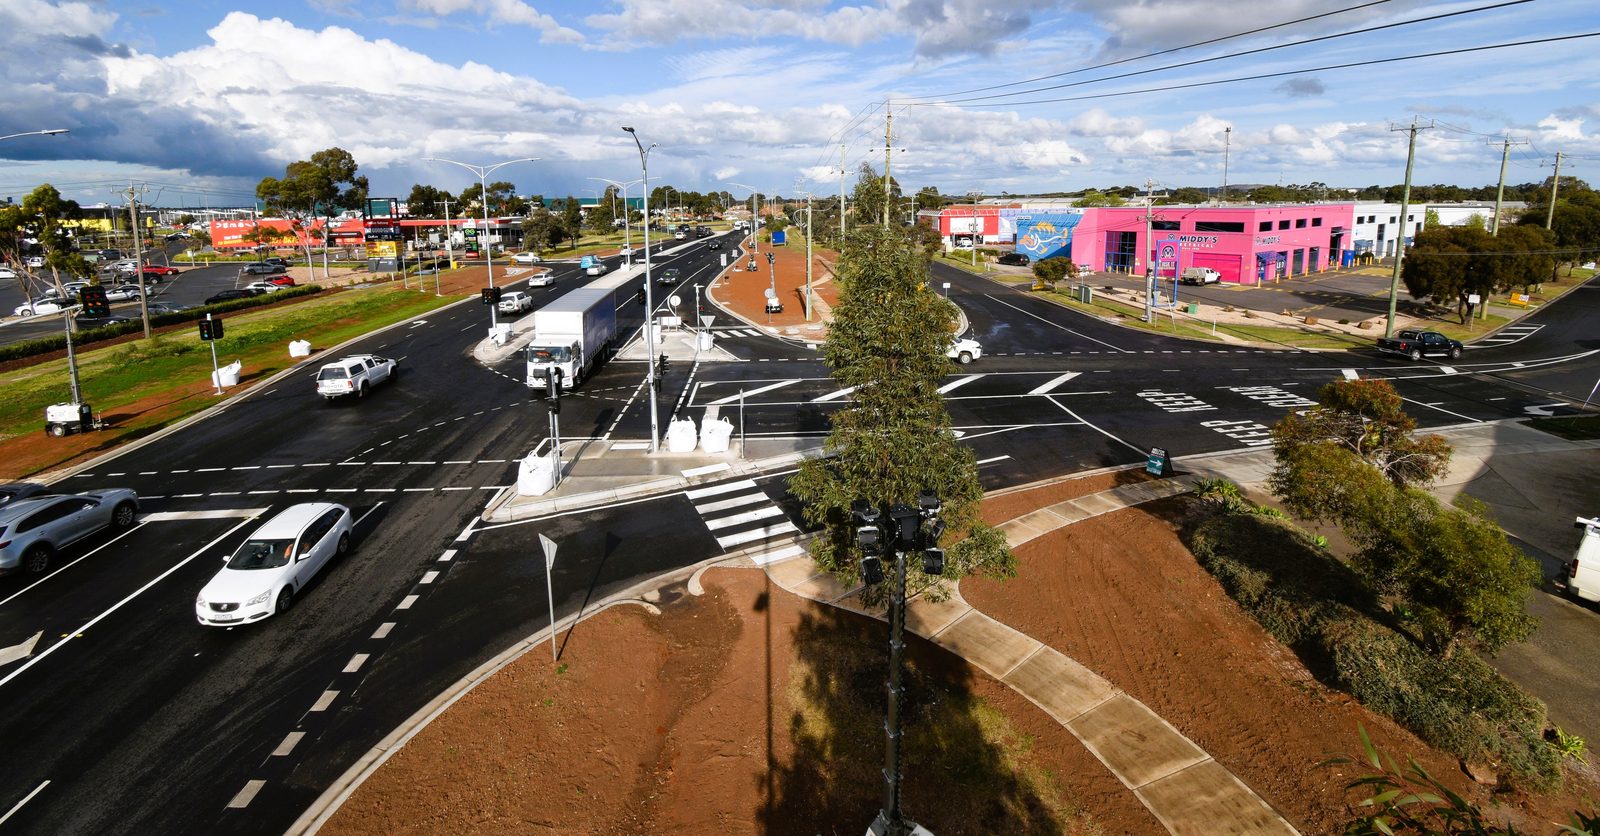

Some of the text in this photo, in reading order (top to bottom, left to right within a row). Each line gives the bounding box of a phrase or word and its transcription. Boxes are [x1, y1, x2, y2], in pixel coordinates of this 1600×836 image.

[1180, 235, 1217, 243] MIDDY'S
[1136, 391, 1218, 413] KEEP
[1229, 385, 1320, 408] CLEAR
